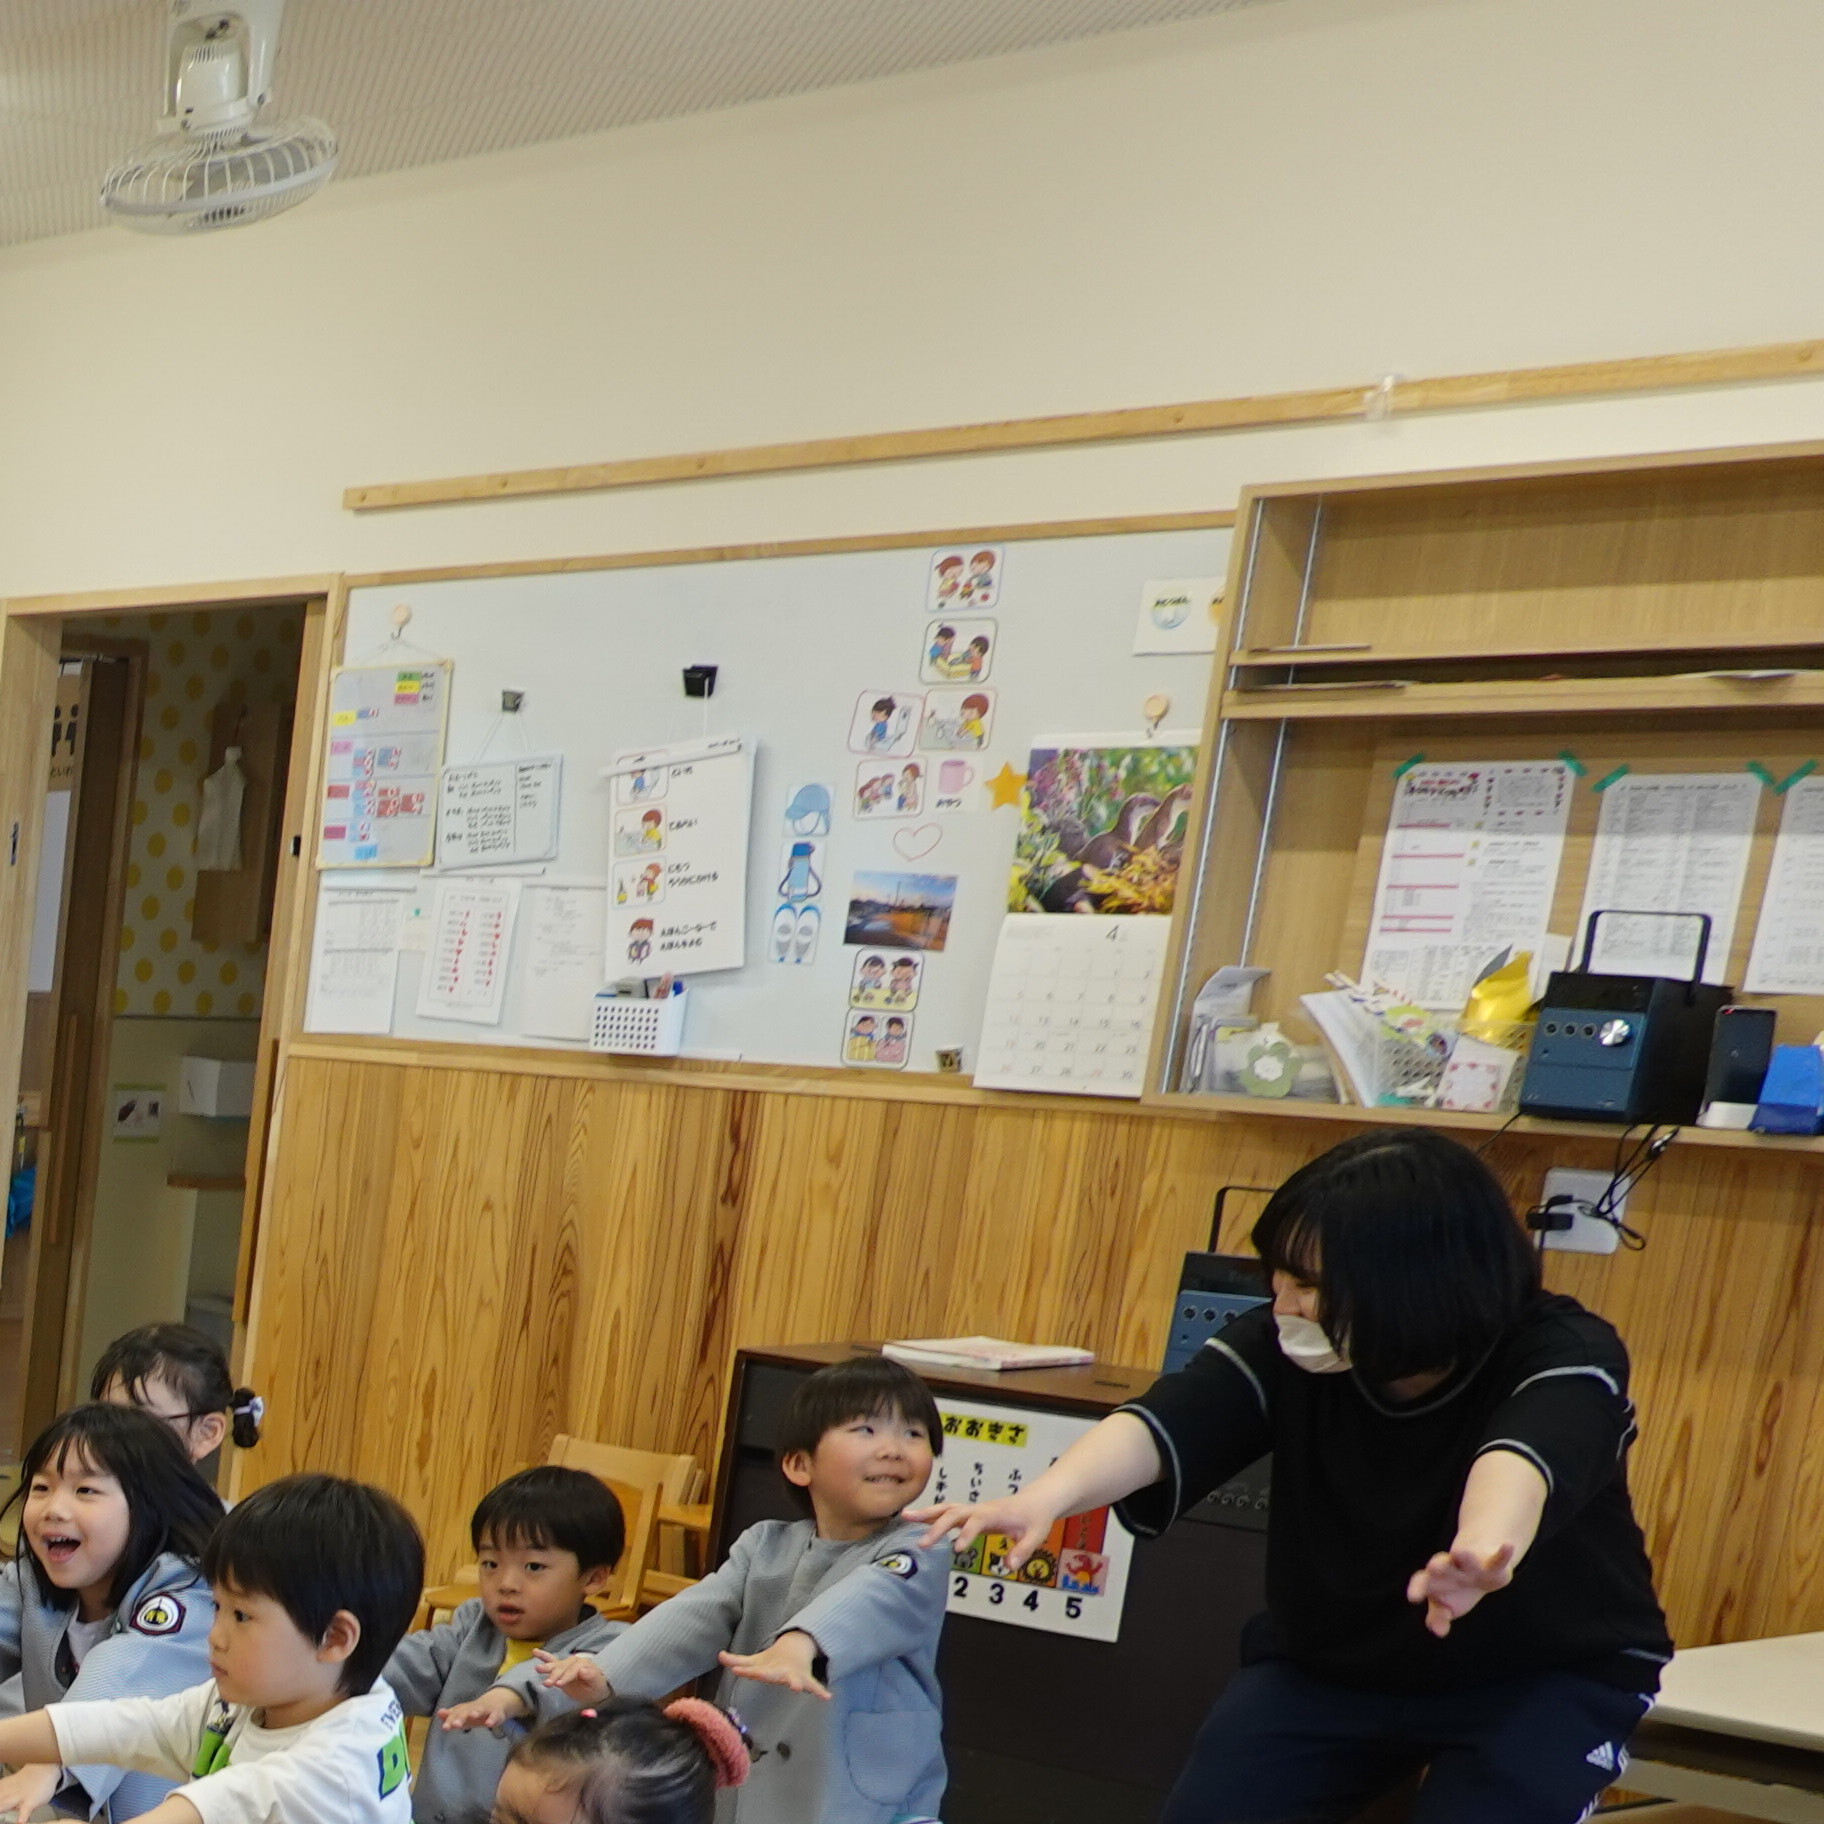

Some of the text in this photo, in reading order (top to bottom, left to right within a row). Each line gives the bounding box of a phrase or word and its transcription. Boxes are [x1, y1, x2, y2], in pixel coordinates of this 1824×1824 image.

[1105, 925, 1120, 942] 4
[944, 1415, 1025, 1444] おおきさ
[954, 1576, 1083, 1619] 2 3 4 5
